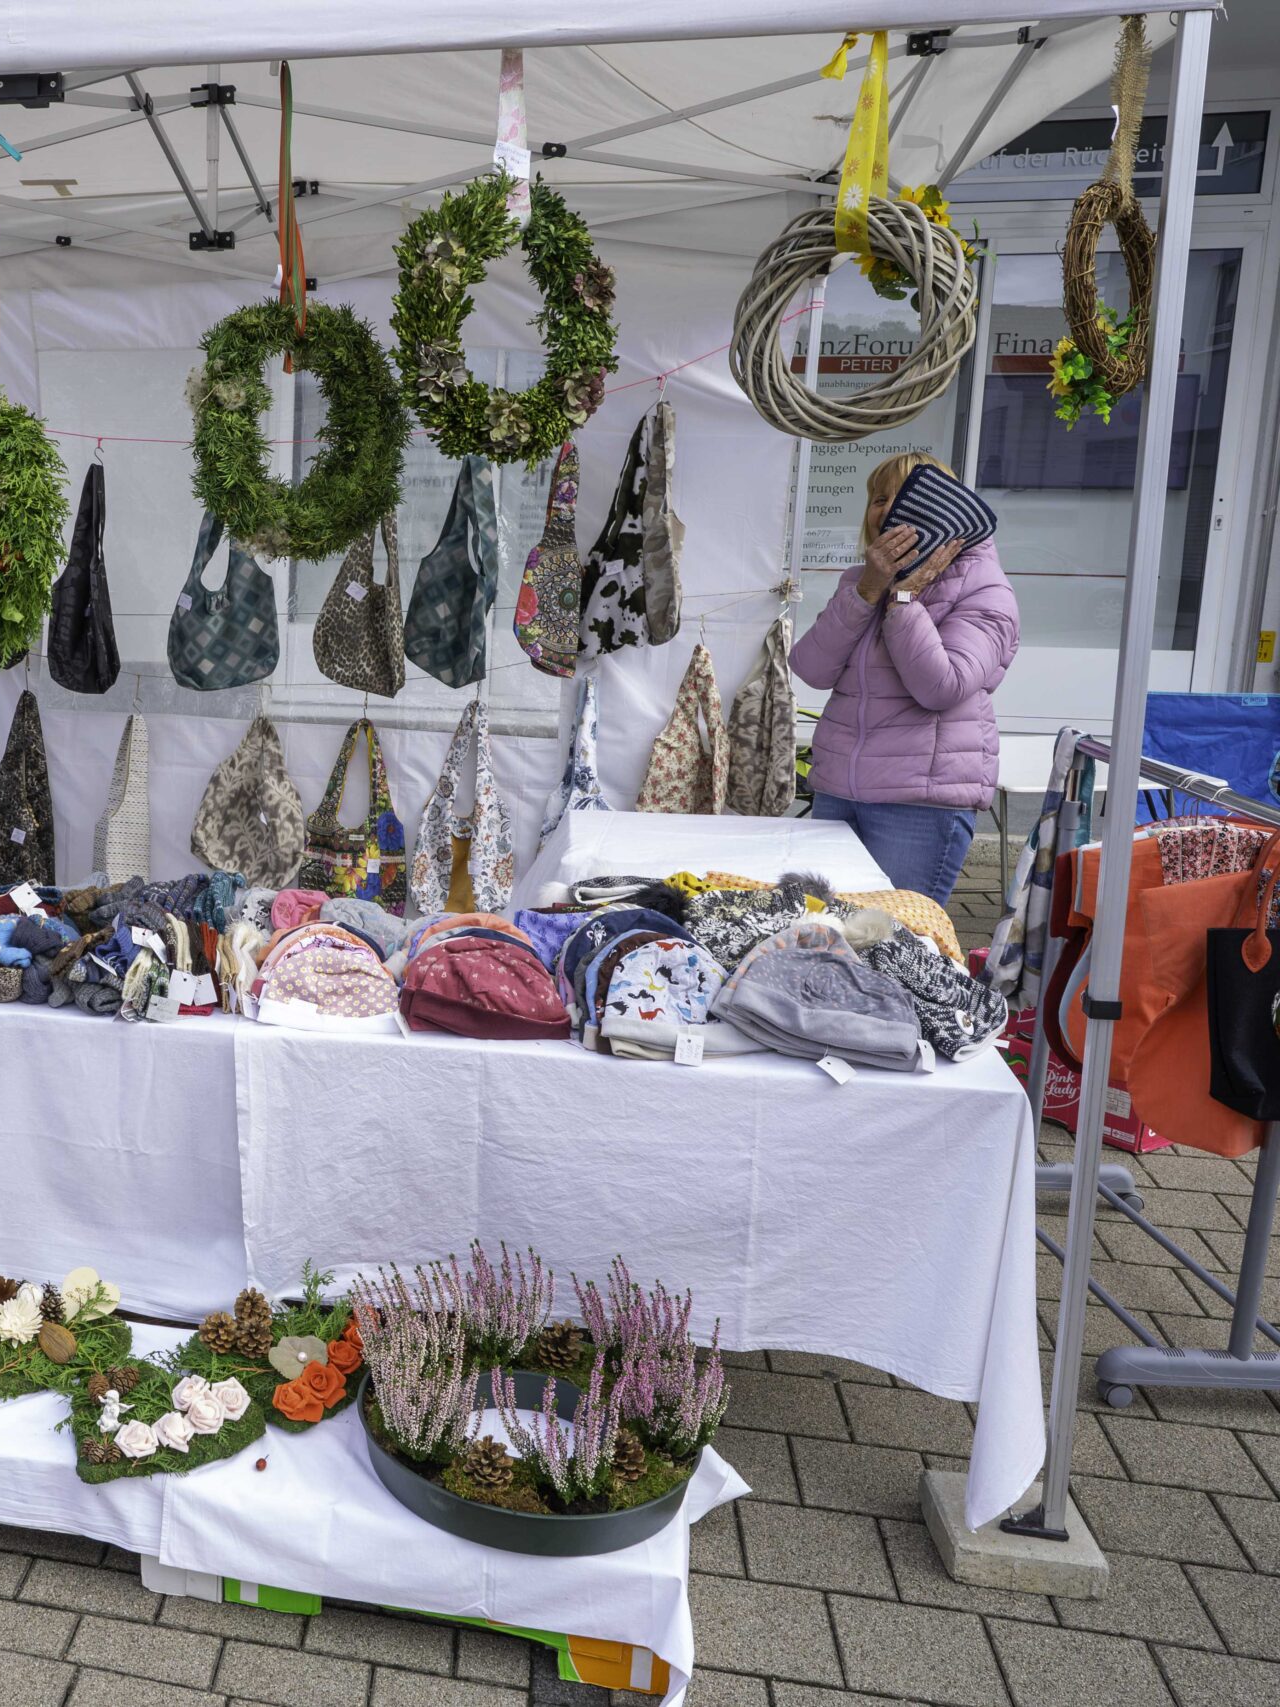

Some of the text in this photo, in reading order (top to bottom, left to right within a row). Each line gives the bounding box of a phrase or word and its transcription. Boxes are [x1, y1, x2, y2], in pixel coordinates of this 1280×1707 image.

[970, 149, 1008, 170] uf
[1013, 147, 1051, 169] der
[840, 359, 893, 372] PETER
[1046, 1070, 1075, 1084] Pink
[1045, 1082, 1077, 1099] Lady
